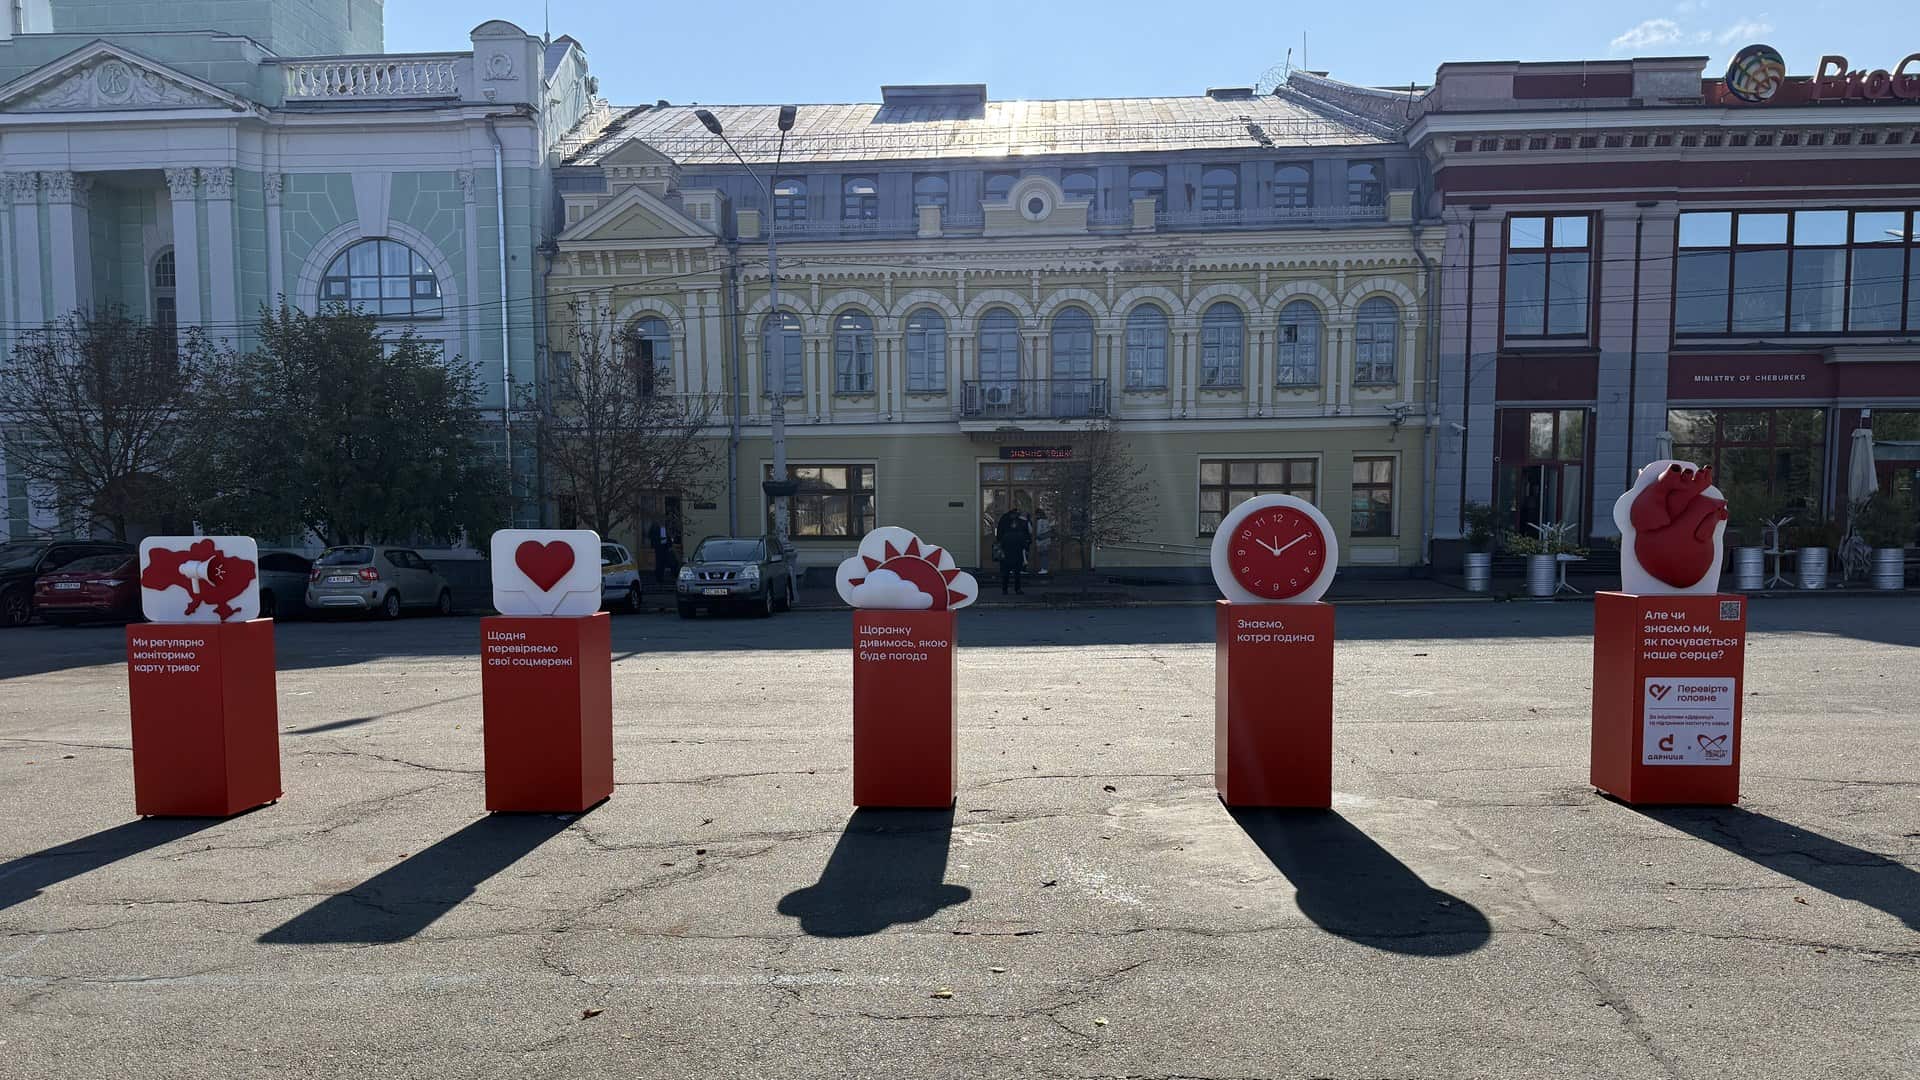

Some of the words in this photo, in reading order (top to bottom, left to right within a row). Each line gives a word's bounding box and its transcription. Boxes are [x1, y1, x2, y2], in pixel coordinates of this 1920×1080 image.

[1255, 517, 1266, 528] 11
[1273, 513, 1284, 523] 12
[1293, 519, 1300, 527] 1
[1241, 529, 1252, 540] 10
[1237, 549, 1246, 557] 9
[1241, 566, 1249, 574] 8
[1303, 566, 1310, 574] 4
[1254, 579, 1262, 587] 7
[1290, 578, 1297, 587] 5
[1644, 611, 1669, 620] Але
[1671, 612, 1686, 620] чи
[1237, 619, 1285, 630] Знаємо,
[1643, 625, 1691, 633] знаємо
[1693, 625, 1713, 634] ми,
[859, 625, 912, 636] Щоранку
[487, 631, 527, 641] Щодня
[1237, 634, 1271, 644] котра
[1273, 634, 1315, 643] година
[132, 638, 148, 647] Ми
[150, 639, 205, 649] регулярно
[859, 640, 917, 648] дивимось,
[919, 640, 948, 648] якою
[1643, 638, 1658, 647] як
[1660, 638, 1738, 648] почувається
[488, 644, 559, 654] перевіряємо
[133, 650, 196, 661] моніторимо
[859, 651, 887, 661] буде
[889, 652, 928, 661] погода
[1643, 651, 1677, 660] наше
[1680, 650, 1725, 661] серце?
[488, 657, 510, 666] свої
[512, 656, 573, 667] соцмережі
[134, 664, 164, 674] карту
[167, 664, 200, 673] тривог
[1677, 684, 1728, 694] Перевірте
